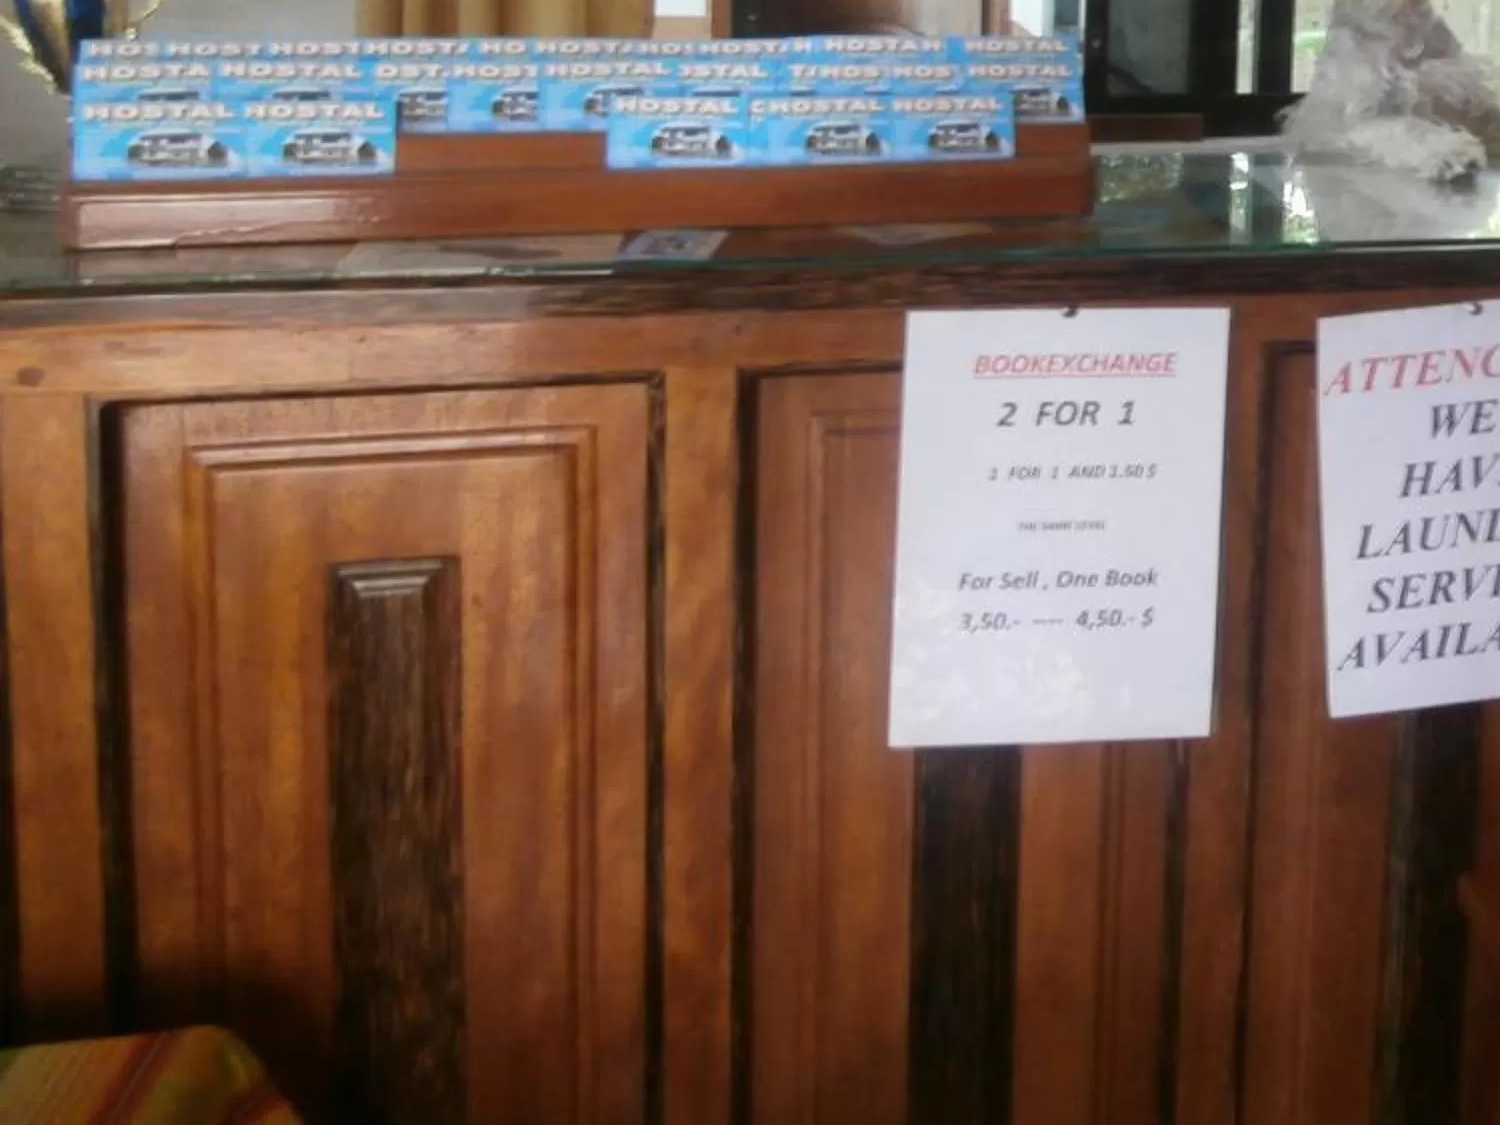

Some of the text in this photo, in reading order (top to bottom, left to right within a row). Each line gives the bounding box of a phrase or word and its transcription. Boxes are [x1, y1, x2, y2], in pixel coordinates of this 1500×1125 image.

[222, 61, 361, 79] HOSTAL
[83, 102, 234, 121] HOSTAL
[244, 102, 385, 120] HOSTAL
[616, 96, 739, 115] HOSTAL
[768, 98, 884, 115] HOSTAL
[894, 97, 1004, 113] HOSTAL
[973, 352, 1178, 377] BOOKEXCHANGE
[997, 401, 1136, 428] 2 FOR 1
[1430, 398, 1499, 440] WE
[1067, 464, 1106, 480] AND
[958, 572, 993, 591] For
[1000, 570, 1040, 590] Sell
[1056, 570, 1098, 589] One
[1104, 567, 1160, 587] Book
